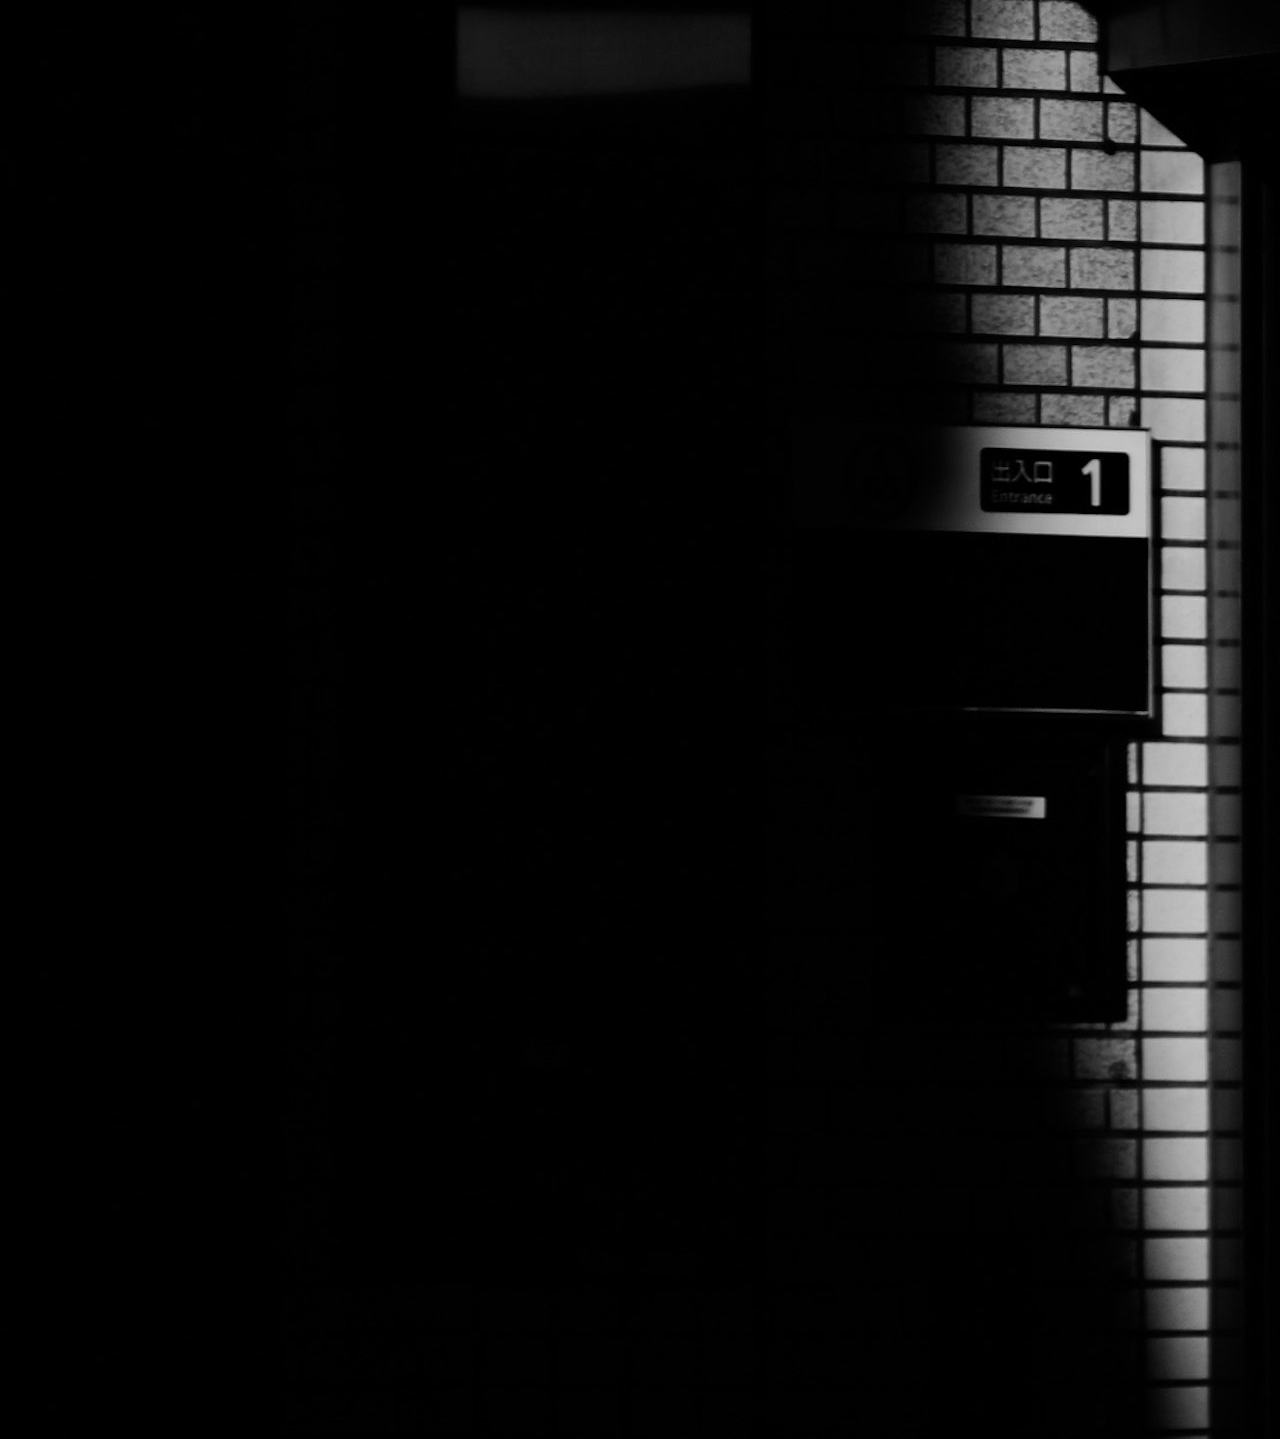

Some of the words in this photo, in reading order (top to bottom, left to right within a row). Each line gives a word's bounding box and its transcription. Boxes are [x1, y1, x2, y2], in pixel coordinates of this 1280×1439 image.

[991, 458, 1053, 484] 出入口
[1081, 458, 1101, 507] 1
[991, 488, 1053, 505] Entrance
